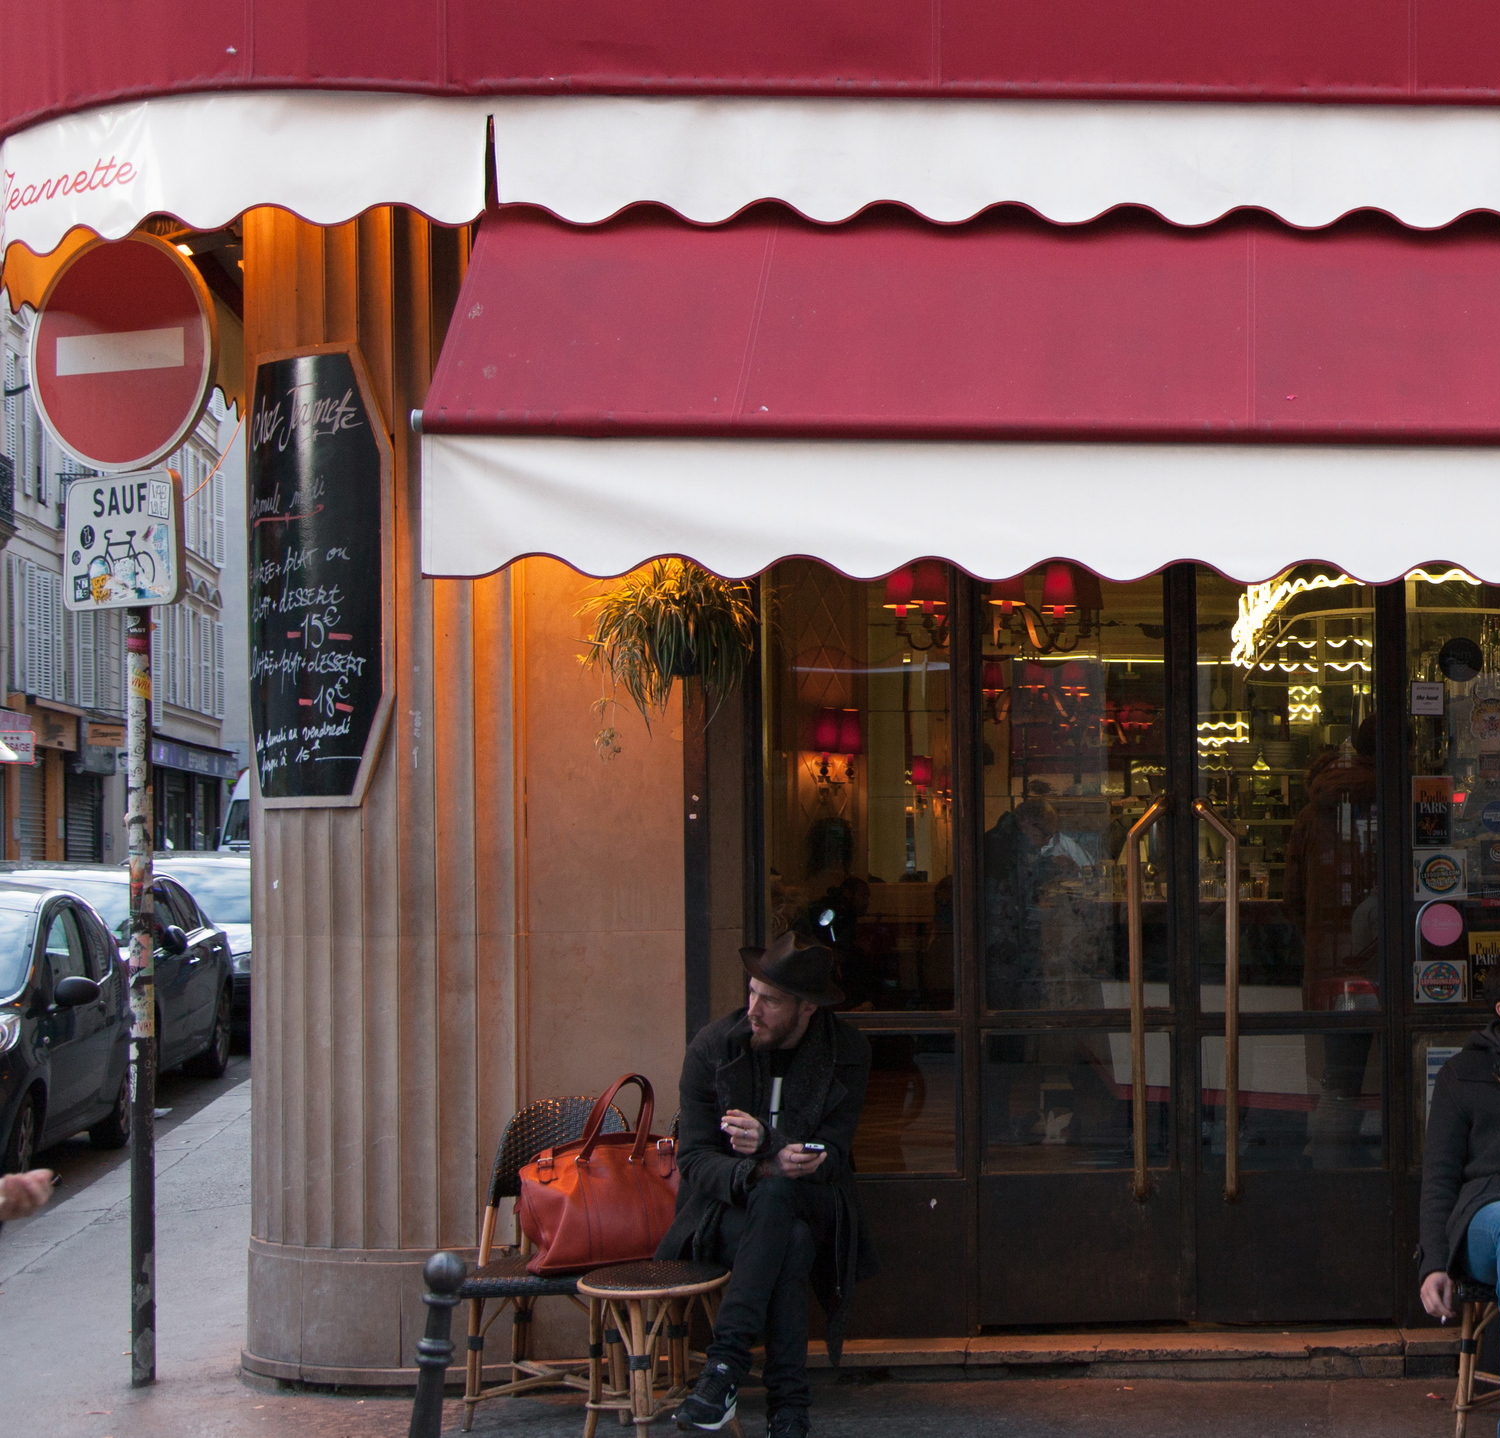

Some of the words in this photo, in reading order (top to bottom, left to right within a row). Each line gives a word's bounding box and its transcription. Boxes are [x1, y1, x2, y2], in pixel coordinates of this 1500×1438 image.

[93, 482, 148, 518] SAUF
[1420, 790, 1447, 803] Pudlo
[1420, 802, 1448, 814] PARIS
[1475, 954, 1498, 966] PARI
